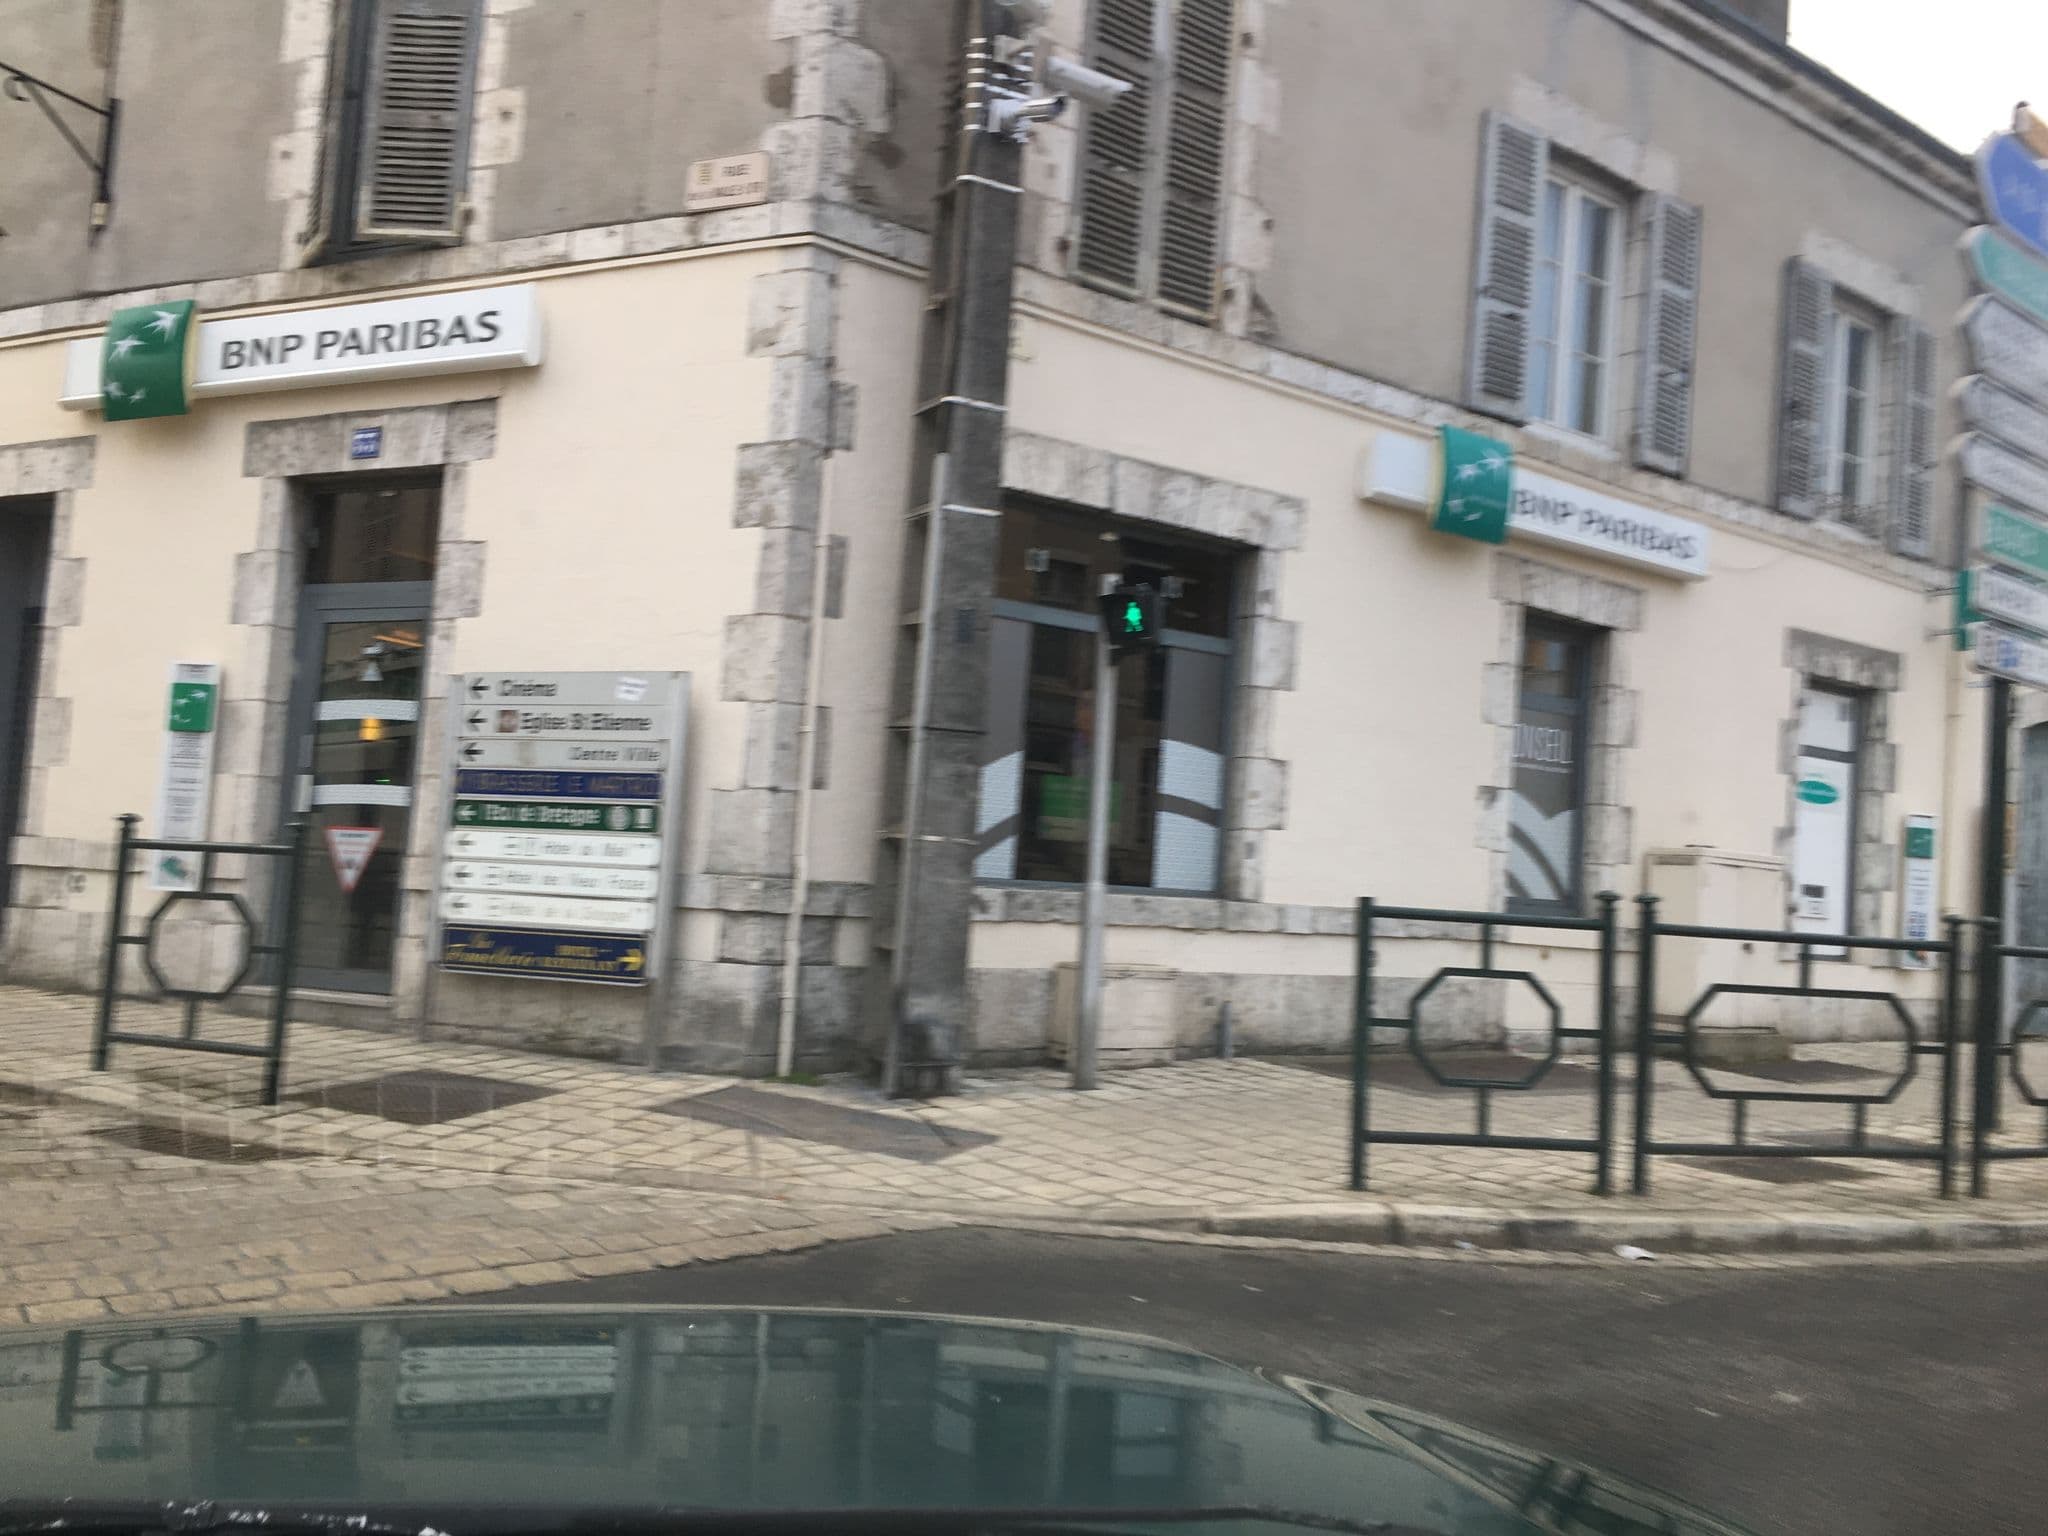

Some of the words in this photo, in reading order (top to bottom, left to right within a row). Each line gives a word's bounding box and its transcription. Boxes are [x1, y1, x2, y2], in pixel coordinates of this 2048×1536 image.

[220, 333, 303, 369] BNP
[314, 310, 501, 360] PARIBAS
[1511, 489, 1576, 524] BNP
[1578, 509, 1697, 559] PARIBAS
